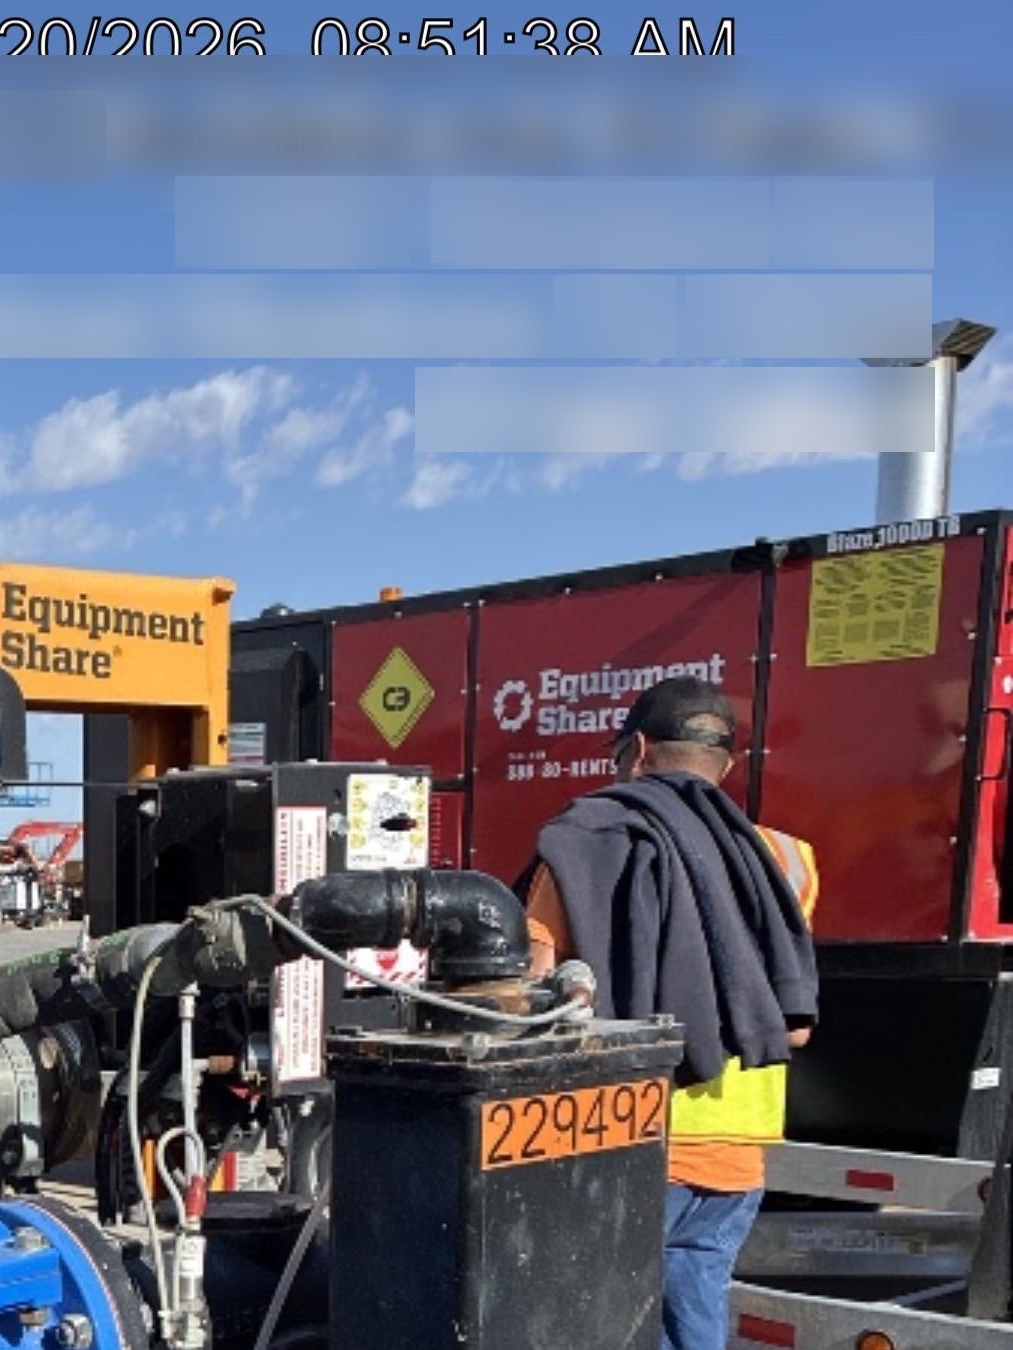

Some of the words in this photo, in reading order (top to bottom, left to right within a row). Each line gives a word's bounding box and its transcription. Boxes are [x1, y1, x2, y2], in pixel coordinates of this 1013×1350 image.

[1, 582, 205, 646] Equipment
[1, 630, 111, 679] Share
[537, 705, 630, 736] Share
[488, 1081, 664, 1164] 229492
